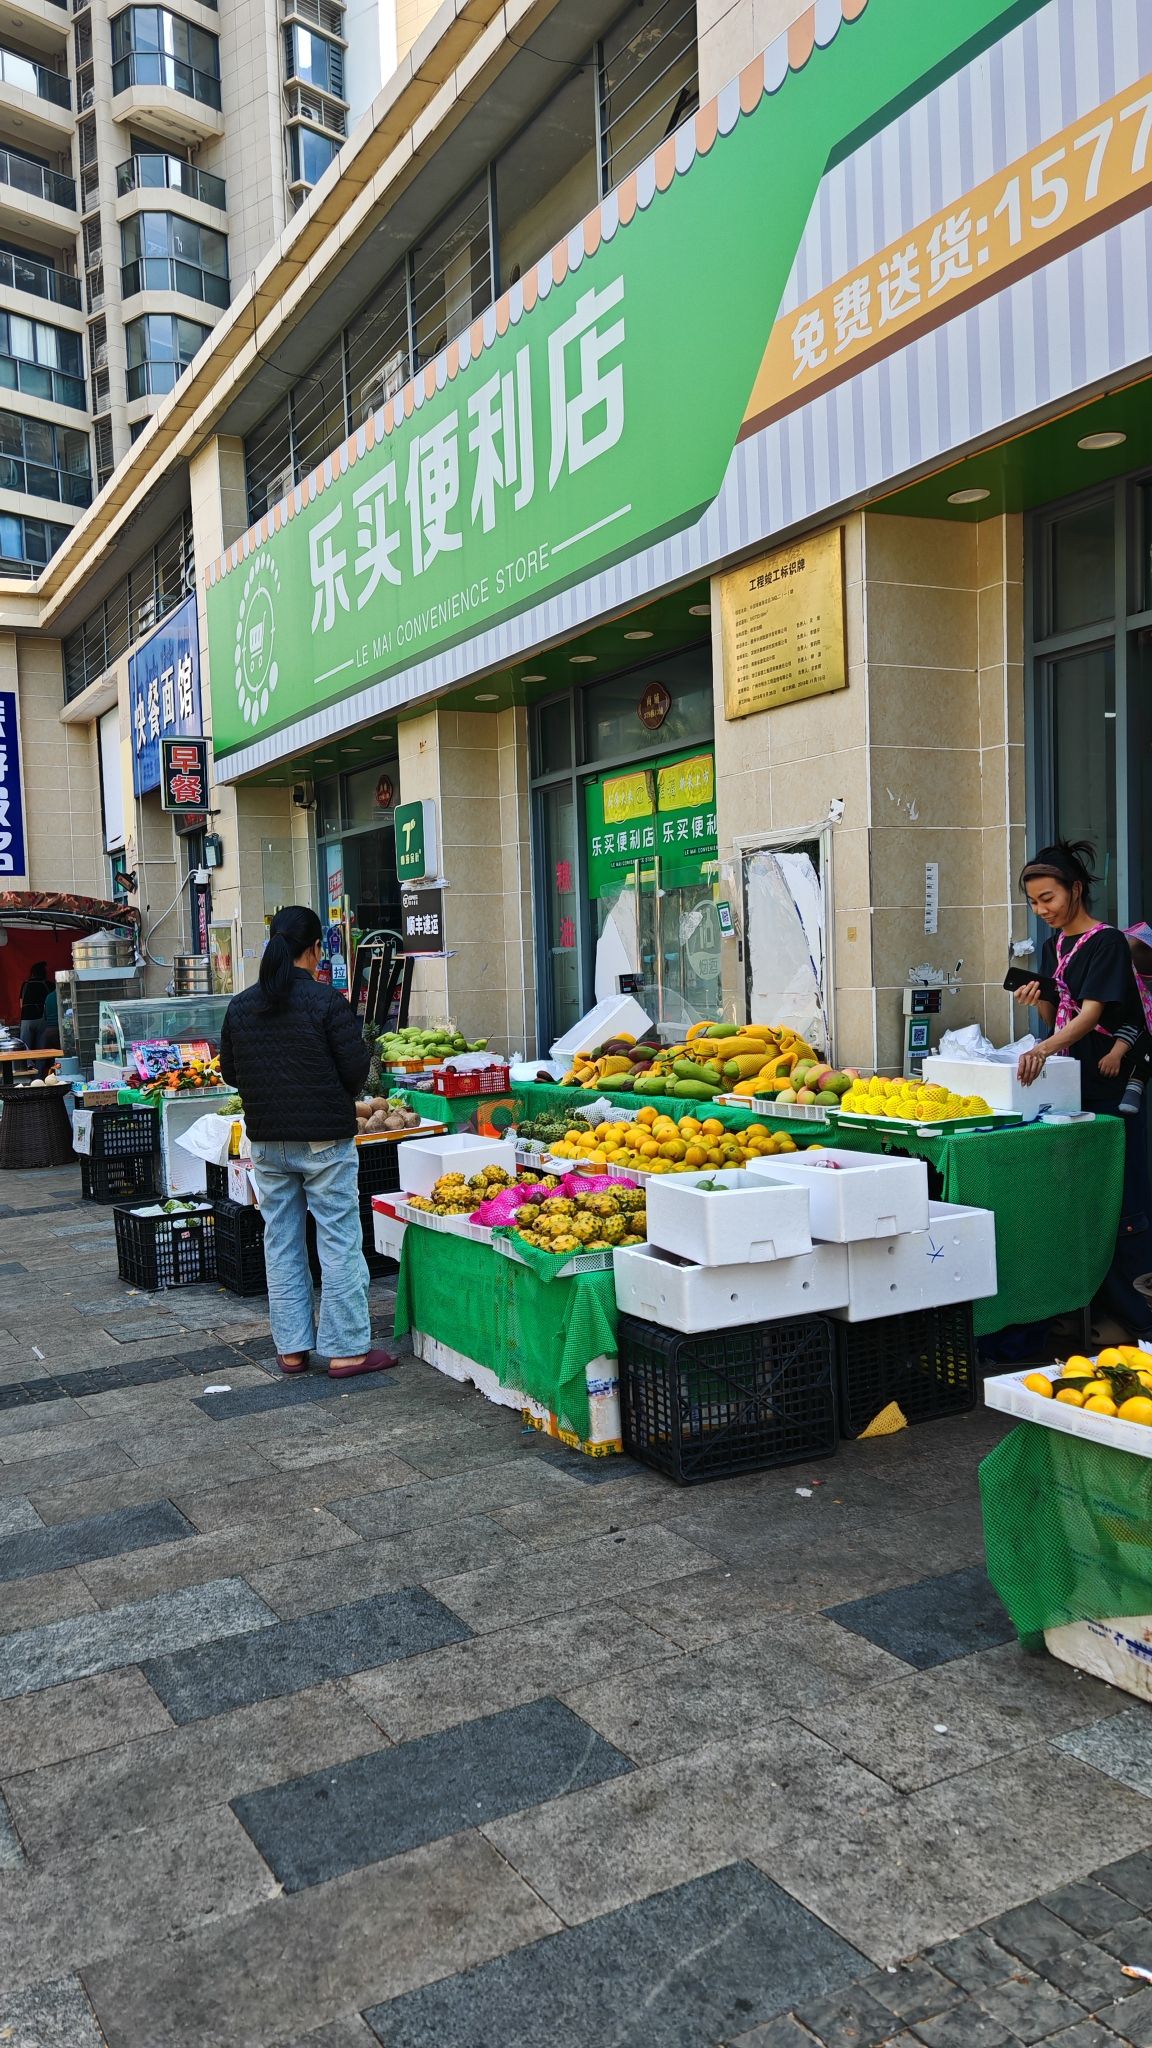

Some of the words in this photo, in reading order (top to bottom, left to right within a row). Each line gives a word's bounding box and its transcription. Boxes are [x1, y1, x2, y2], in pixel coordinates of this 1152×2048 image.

[308, 275, 625, 635] 乐买便利店
[749, 558, 806, 592] 工程竣工标识牌
[356, 644, 369, 668] LE
[372, 631, 392, 660] MAI
[396, 577, 489, 646] CONVENIENCE
[496, 542, 550, 594] STORE
[134, 652, 195, 750] 快餐面馆
[170, 746, 201, 803] 早餐
[592, 827, 654, 857] 乐买便利店
[406, 914, 439, 936] 顺丰速运
[333, 966, 346, 978] 拉
